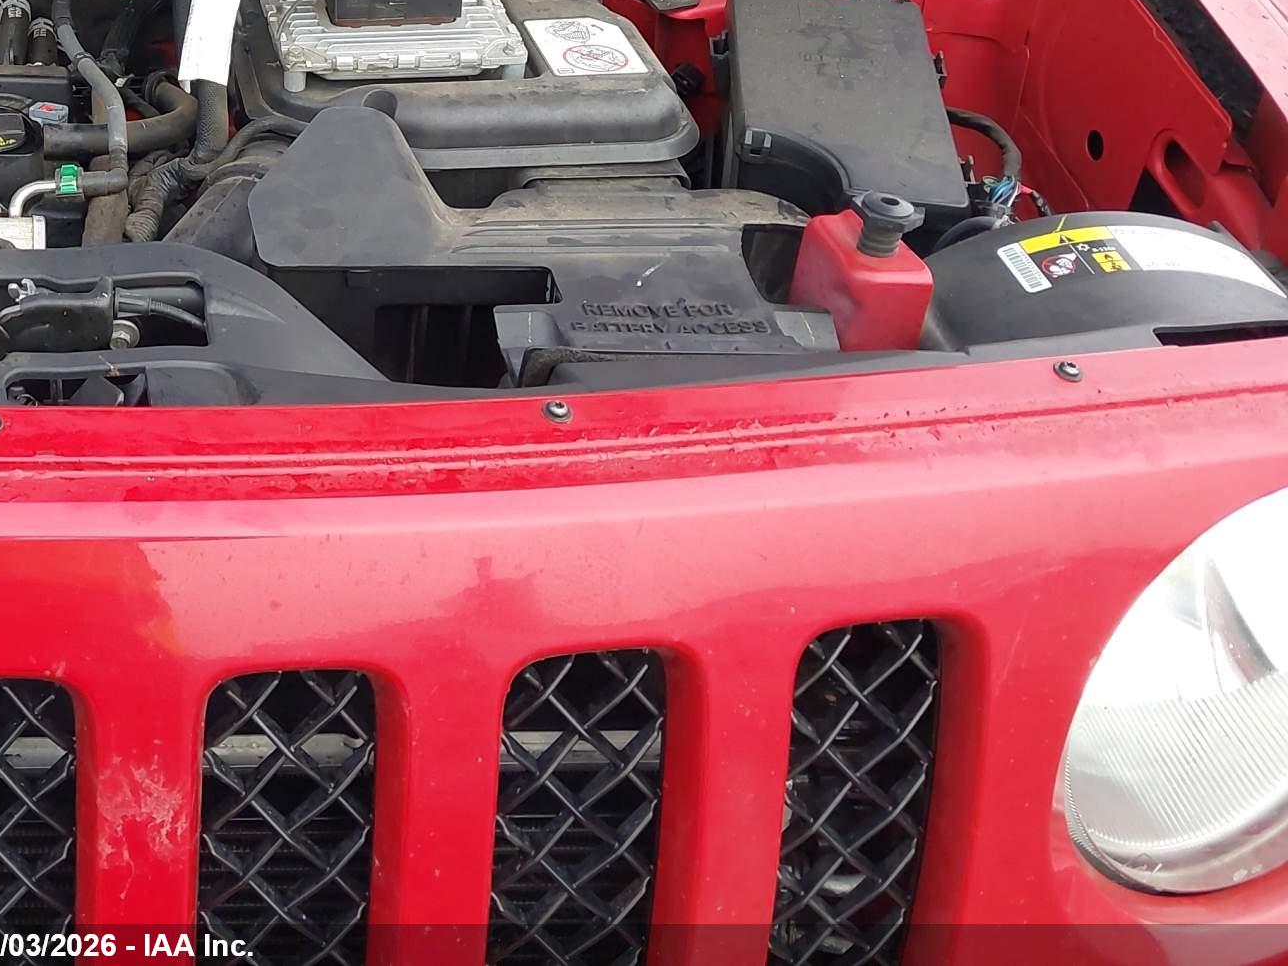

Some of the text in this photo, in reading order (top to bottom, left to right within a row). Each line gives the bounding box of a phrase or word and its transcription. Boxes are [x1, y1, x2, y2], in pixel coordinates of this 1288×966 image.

[581, 301, 734, 318] REMOVE FOR
[569, 320, 770, 335] BATTERY ACCESS
